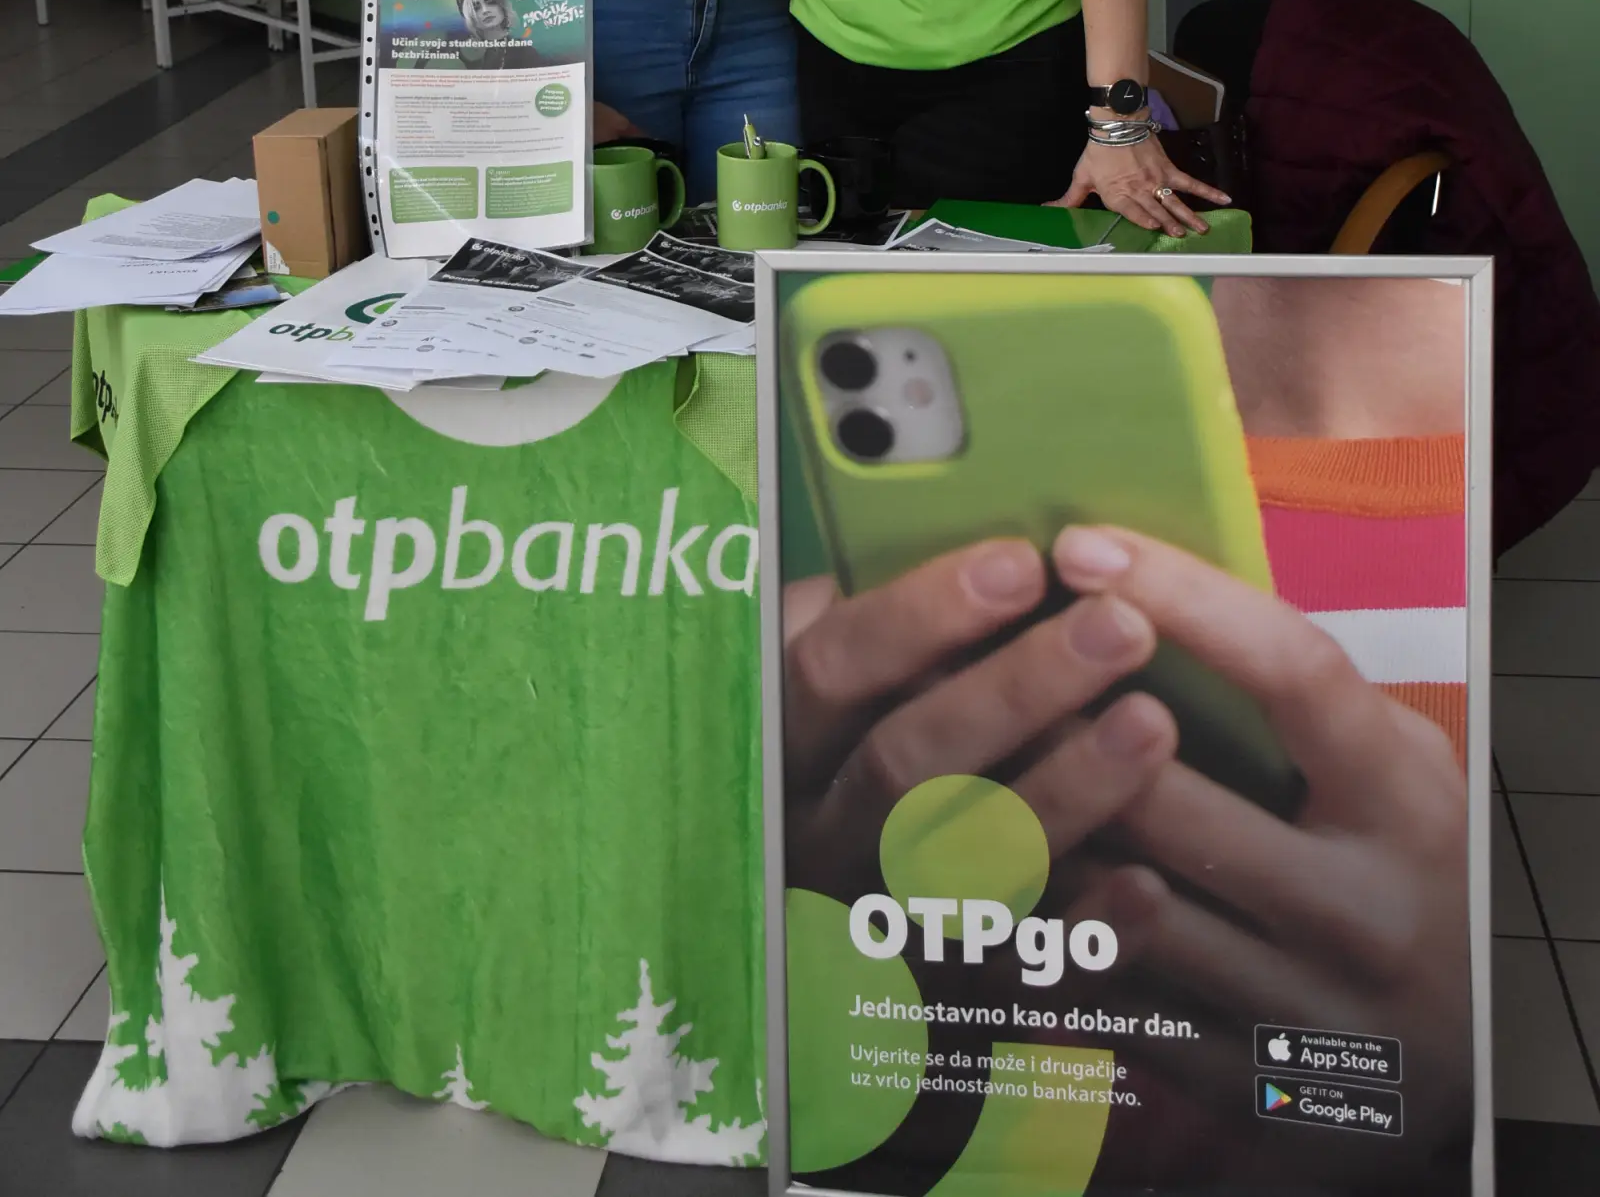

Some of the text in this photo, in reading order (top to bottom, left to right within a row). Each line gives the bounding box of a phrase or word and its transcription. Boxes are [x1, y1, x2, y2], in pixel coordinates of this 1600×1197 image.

[391, 37, 533, 49] Učini svoje studentske dane
[391, 50, 460, 61] bezbrižnima!
[744, 199, 788, 214] otpbanka
[257, 484, 759, 622] otpbanka
[848, 892, 1119, 987] OTPgo
[848, 994, 1201, 1039] Jednostavno kao dobar dan.
[1300, 1035, 1346, 1048] Available
[1365, 1042, 1382, 1052] the
[850, 1044, 1127, 1082] Uvjerite se da može i drugačije
[1300, 1047, 1388, 1073] App Store
[850, 1070, 1142, 1106] uz vrlo jednostavno bankarstvo.
[1299, 1086, 1343, 1099] GET IT ON
[1299, 1097, 1393, 1129] Google Play
